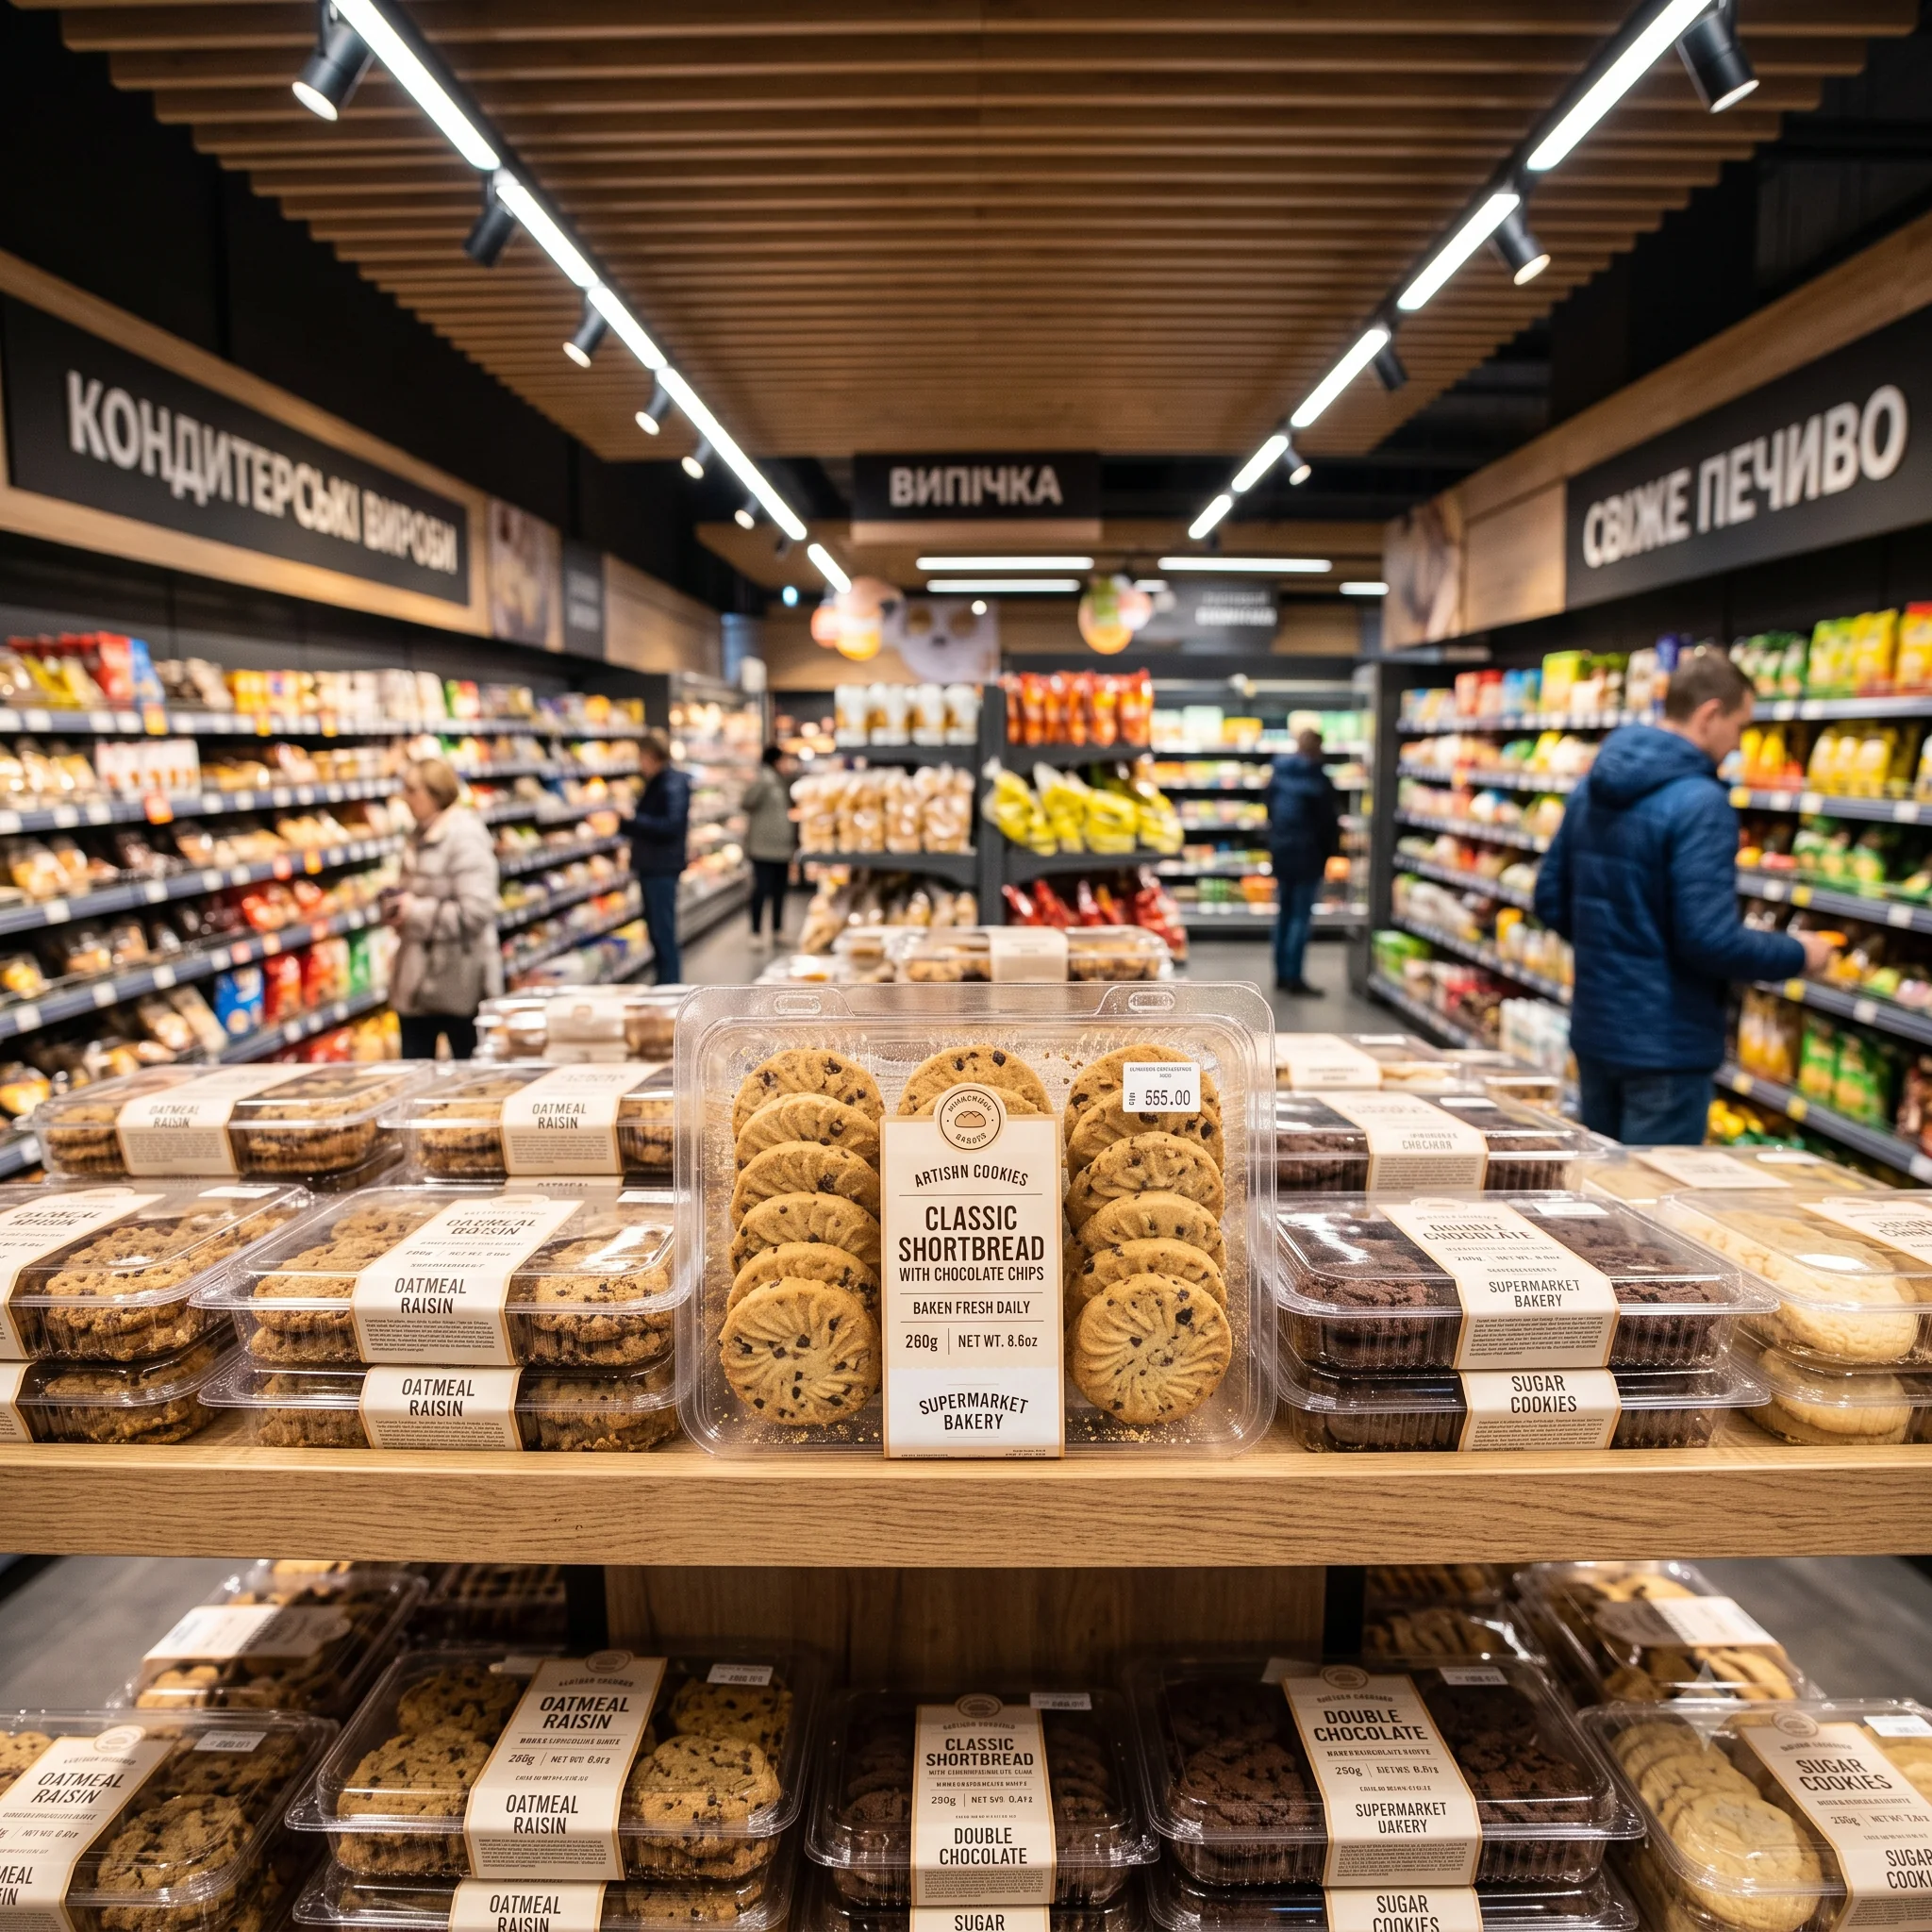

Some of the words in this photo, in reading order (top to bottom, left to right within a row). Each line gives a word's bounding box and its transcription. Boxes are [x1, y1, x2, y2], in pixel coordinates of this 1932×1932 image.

[67, 369, 360, 541] КОНДИТЕРСЬКІ
[1583, 468, 1691, 568] СВІЖЕ
[1698, 384, 1908, 534] ПЕЧИВО
[889, 466, 1063, 508] ВИПІЧКА
[532, 1103, 587, 1115] OATMEAL
[538, 1116, 578, 1129] RAISIN
[974, 1164, 1028, 1187] COOKIES
[925, 1205, 1017, 1231] CLASSIC
[898, 1236, 1044, 1262] SHORTBREAD
[899, 1267, 930, 1282] WITH
[934, 1266, 1005, 1281] CHOCOLATE
[1008, 1266, 1044, 1281] CHIPS
[394, 1277, 467, 1294] OATMEAL
[1489, 1279, 1580, 1293] SUPERMARKET
[401, 1297, 454, 1314] RAISIN
[913, 1301, 952, 1315] BAKEN
[956, 1301, 993, 1314] FRESH
[996, 1300, 1031, 1314] DAILY
[1514, 1294, 1562, 1307] BAKERY
[906, 1334, 939, 1352] 260g
[958, 1334, 981, 1348] NET
[983, 1334, 1005, 1348] WT.
[1008, 1334, 1038, 1348] 8.6oz
[401, 1378, 475, 1397] OATMEAL
[1511, 1374, 1566, 1392] SUGAR
[409, 1399, 463, 1417] RAISIN
[919, 1392, 1029, 1415] SUPERMARKET
[1510, 1395, 1577, 1413] COOKIES
[943, 1413, 1004, 1430] BAKERY
[540, 1696, 630, 1712] OATMEAL
[542, 1713, 613, 1729] RAISIN
[1324, 1709, 1403, 1724] DOUBLE
[1313, 1725, 1428, 1741] CHOCOLATE
[945, 1738, 1014, 1751] CLASSIC
[925, 1753, 1034, 1766] SHORTBREAD
[1795, 1758, 1868, 1774] SUGAR
[38, 1773, 125, 1789] OATMEAL
[1799, 1774, 1892, 1791] COOKIES
[31, 1789, 102, 1804] RAISIN
[506, 1794, 579, 1814] OATMEAL
[1355, 1802, 1447, 1818] SUPERMARKET
[513, 1816, 567, 1835] RAISIN
[954, 1827, 1013, 1844] DOUBLE
[939, 1848, 1027, 1865] CHOCOLATE
[490, 1894, 561, 1914] OATMEAL
[1376, 1894, 1429, 1913] SUGAR
[497, 1916, 550, 1932] RAISIN
[954, 1914, 1005, 1931] SUGAR
[1373, 1917, 1440, 1932] COOKIES
